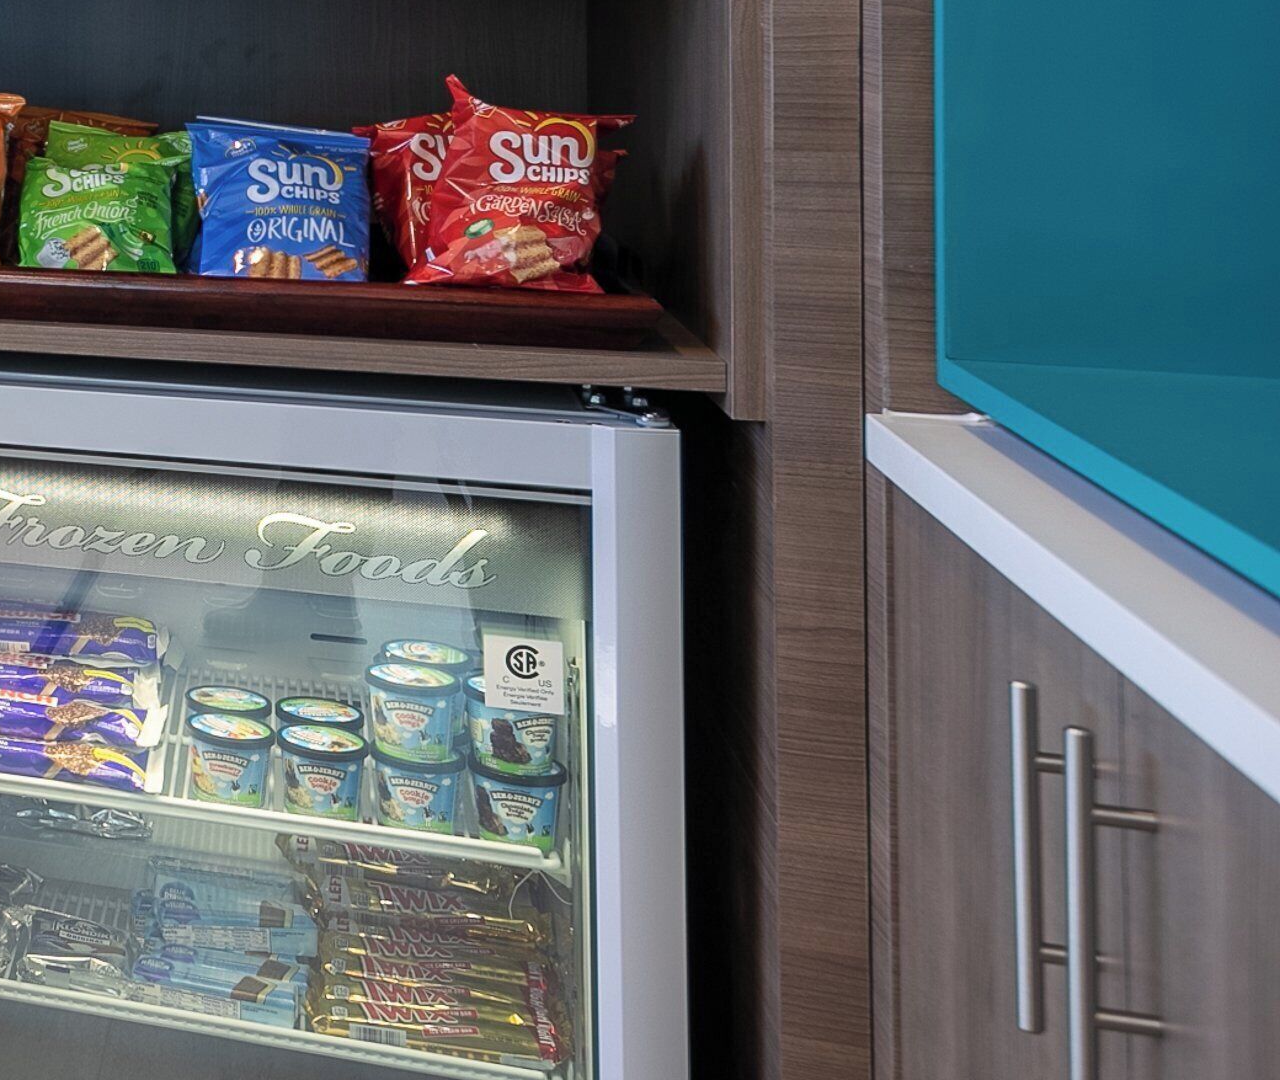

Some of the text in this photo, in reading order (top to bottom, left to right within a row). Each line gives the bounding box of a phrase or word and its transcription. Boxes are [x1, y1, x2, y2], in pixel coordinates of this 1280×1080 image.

[489, 131, 595, 183] Sun
[72, 173, 125, 192] CHIPS
[247, 158, 343, 204] Sun
[527, 165, 590, 185] CHIPS
[281, 185, 340, 204] CHIPS
[552, 187, 579, 203] GRAIN
[35, 200, 131, 240] French Onion
[255, 204, 337, 218] 100% WHOLE GRAIN
[247, 216, 355, 248] ORIGINAL
[243, 511, 497, 590] Foods
[503, 675, 552, 688] C US
[394, 712, 425, 723] cookie
[400, 788, 430, 801] cookie
[367, 881, 467, 912] TWIX
[361, 980, 458, 1005] TWIX
[361, 1001, 458, 1023] TWIX
